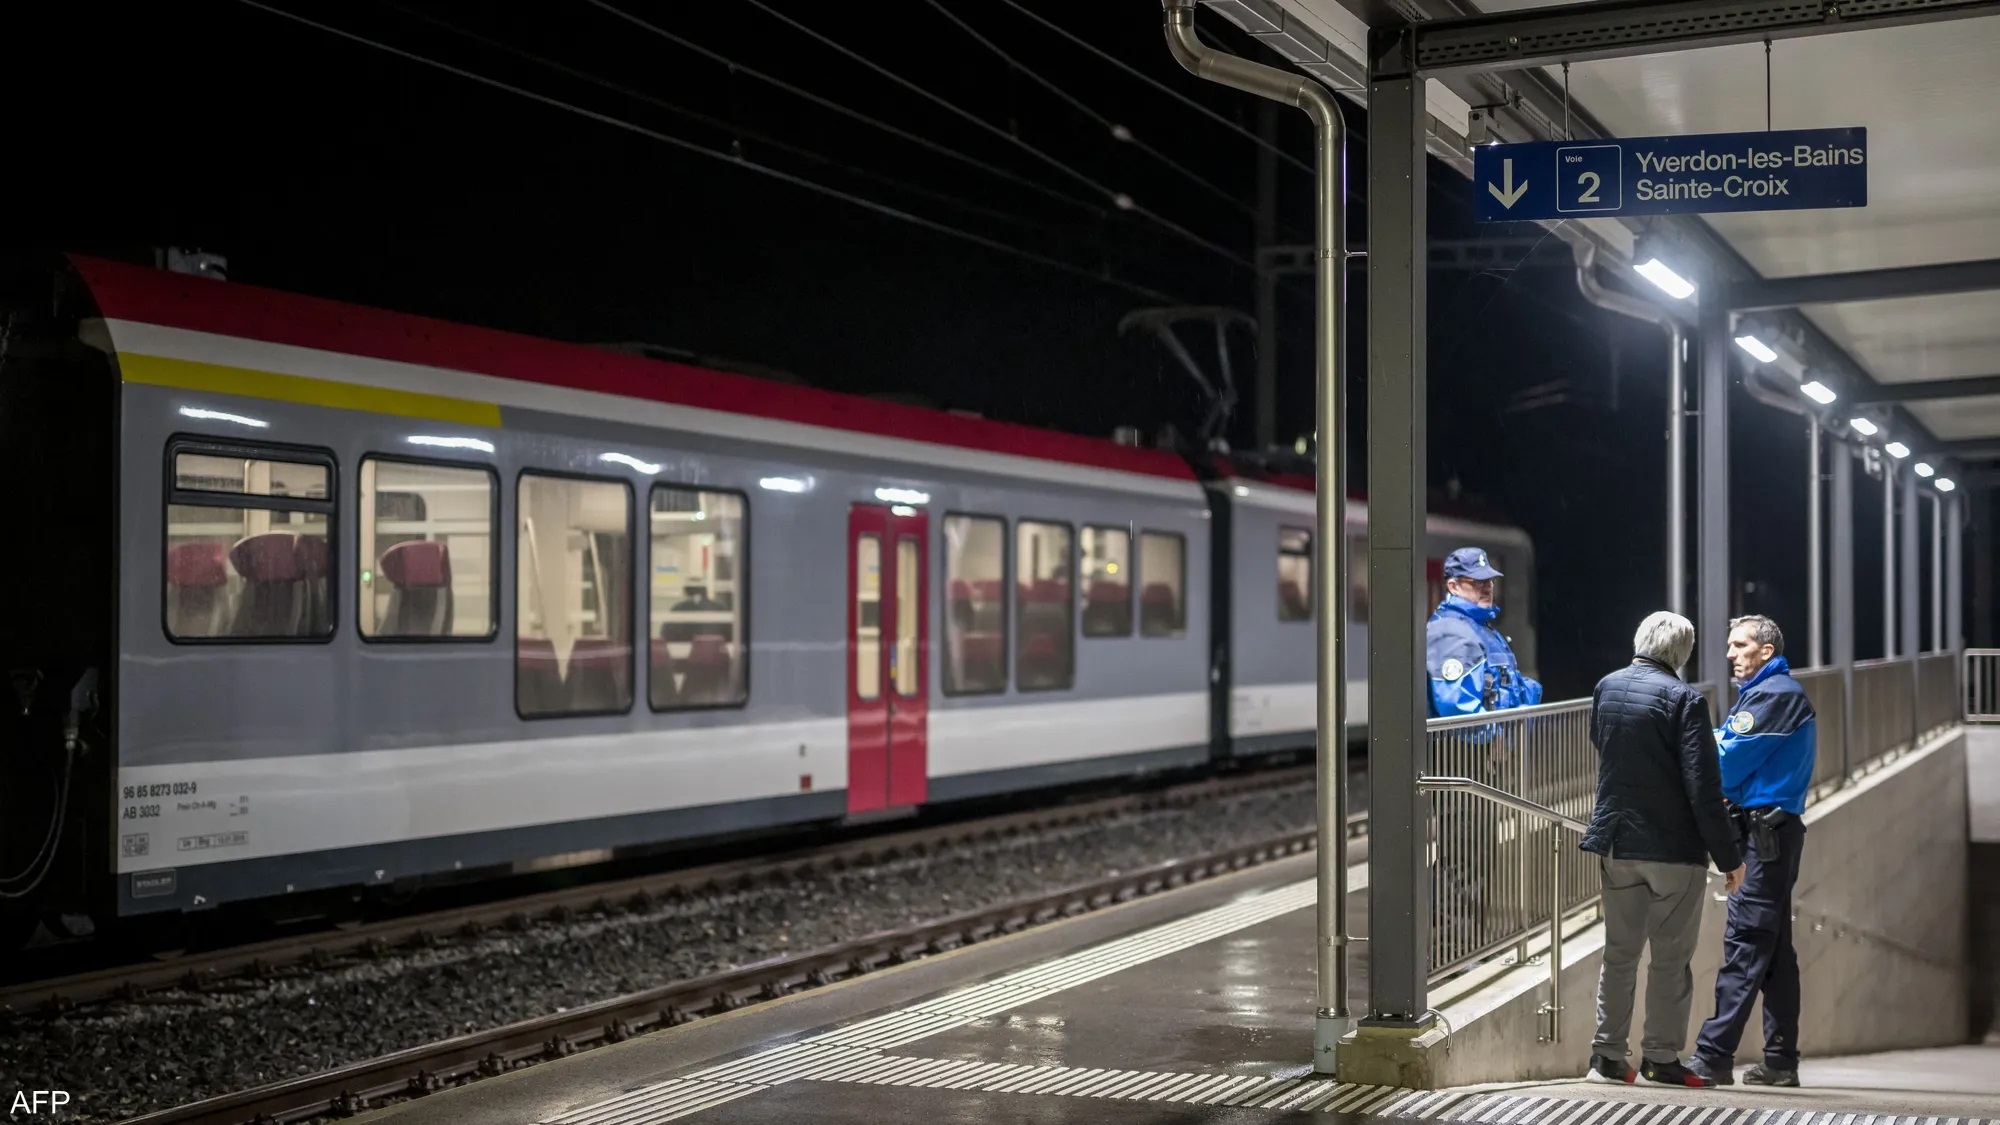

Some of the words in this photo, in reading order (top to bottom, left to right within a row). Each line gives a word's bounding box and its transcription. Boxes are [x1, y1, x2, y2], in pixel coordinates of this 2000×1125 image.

[1564, 155, 1583, 163] Voie
[1635, 144, 1864, 173] Yverdon-les-Bains
[1577, 171, 1601, 203] 2
[1636, 174, 1790, 201] Sainte-Croix
[123, 786, 135, 799] 96
[150, 783, 171, 797] 8273
[173, 781, 197, 795] 032-9
[122, 805, 137, 819] AB
[139, 803, 161, 817] 3032
